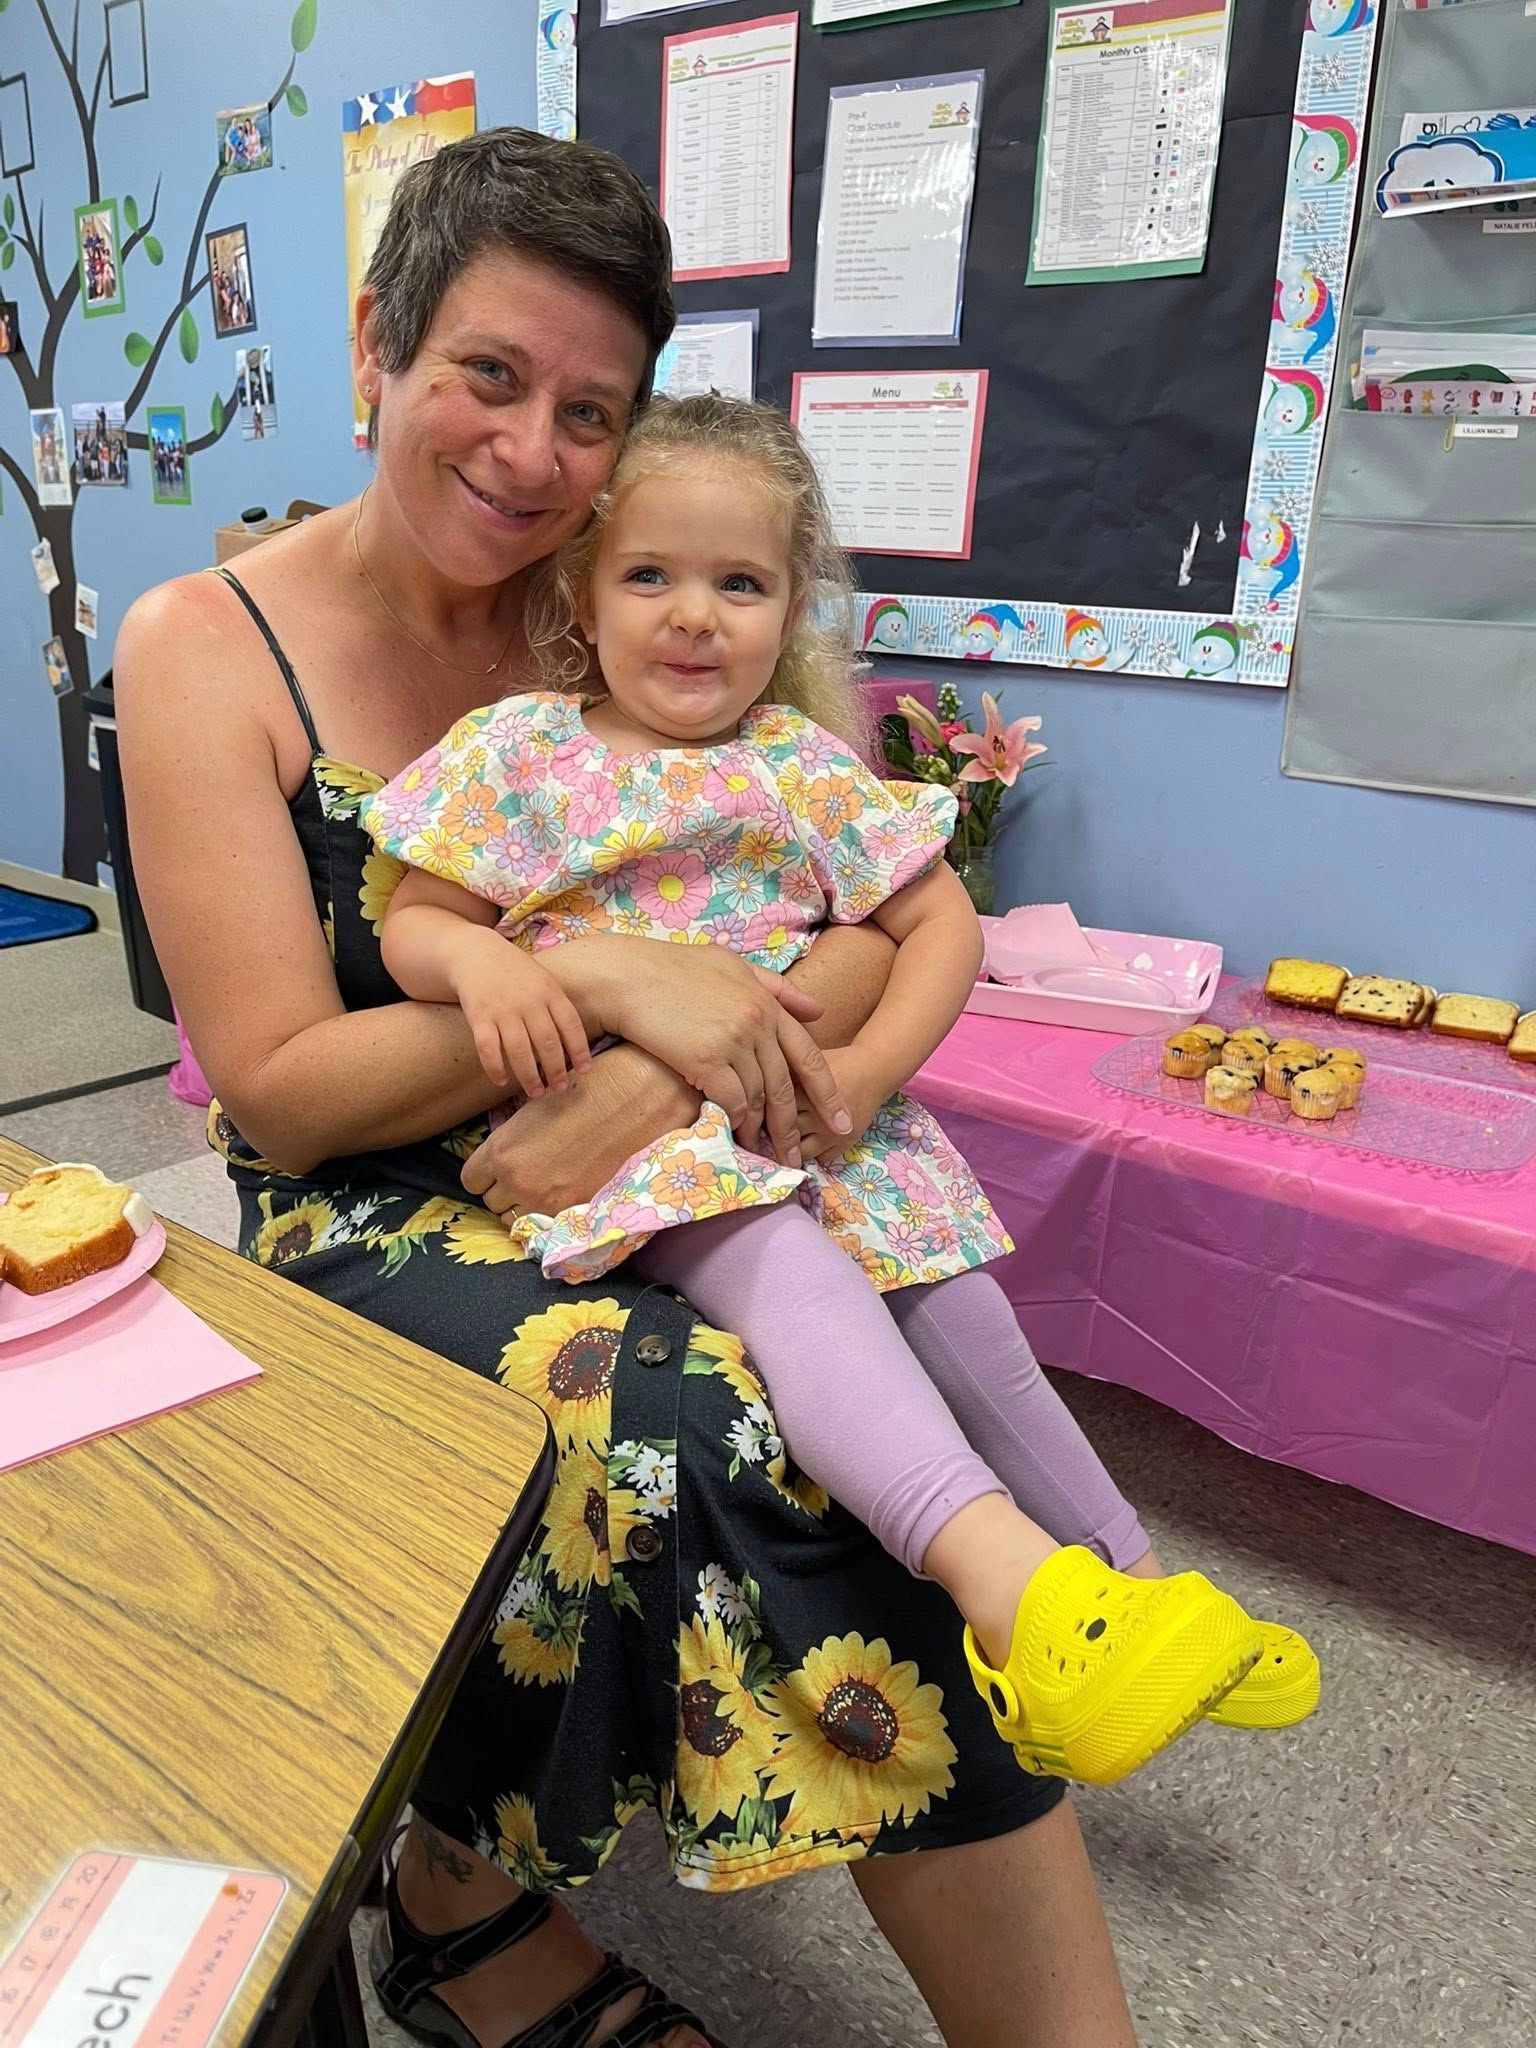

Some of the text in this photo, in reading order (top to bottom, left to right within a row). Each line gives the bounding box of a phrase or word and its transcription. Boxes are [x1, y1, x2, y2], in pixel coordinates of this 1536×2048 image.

[1099, 47, 1131, 58] Monthly
[872, 387, 901, 398] Menu
[76, 1865, 98, 1885] 20
